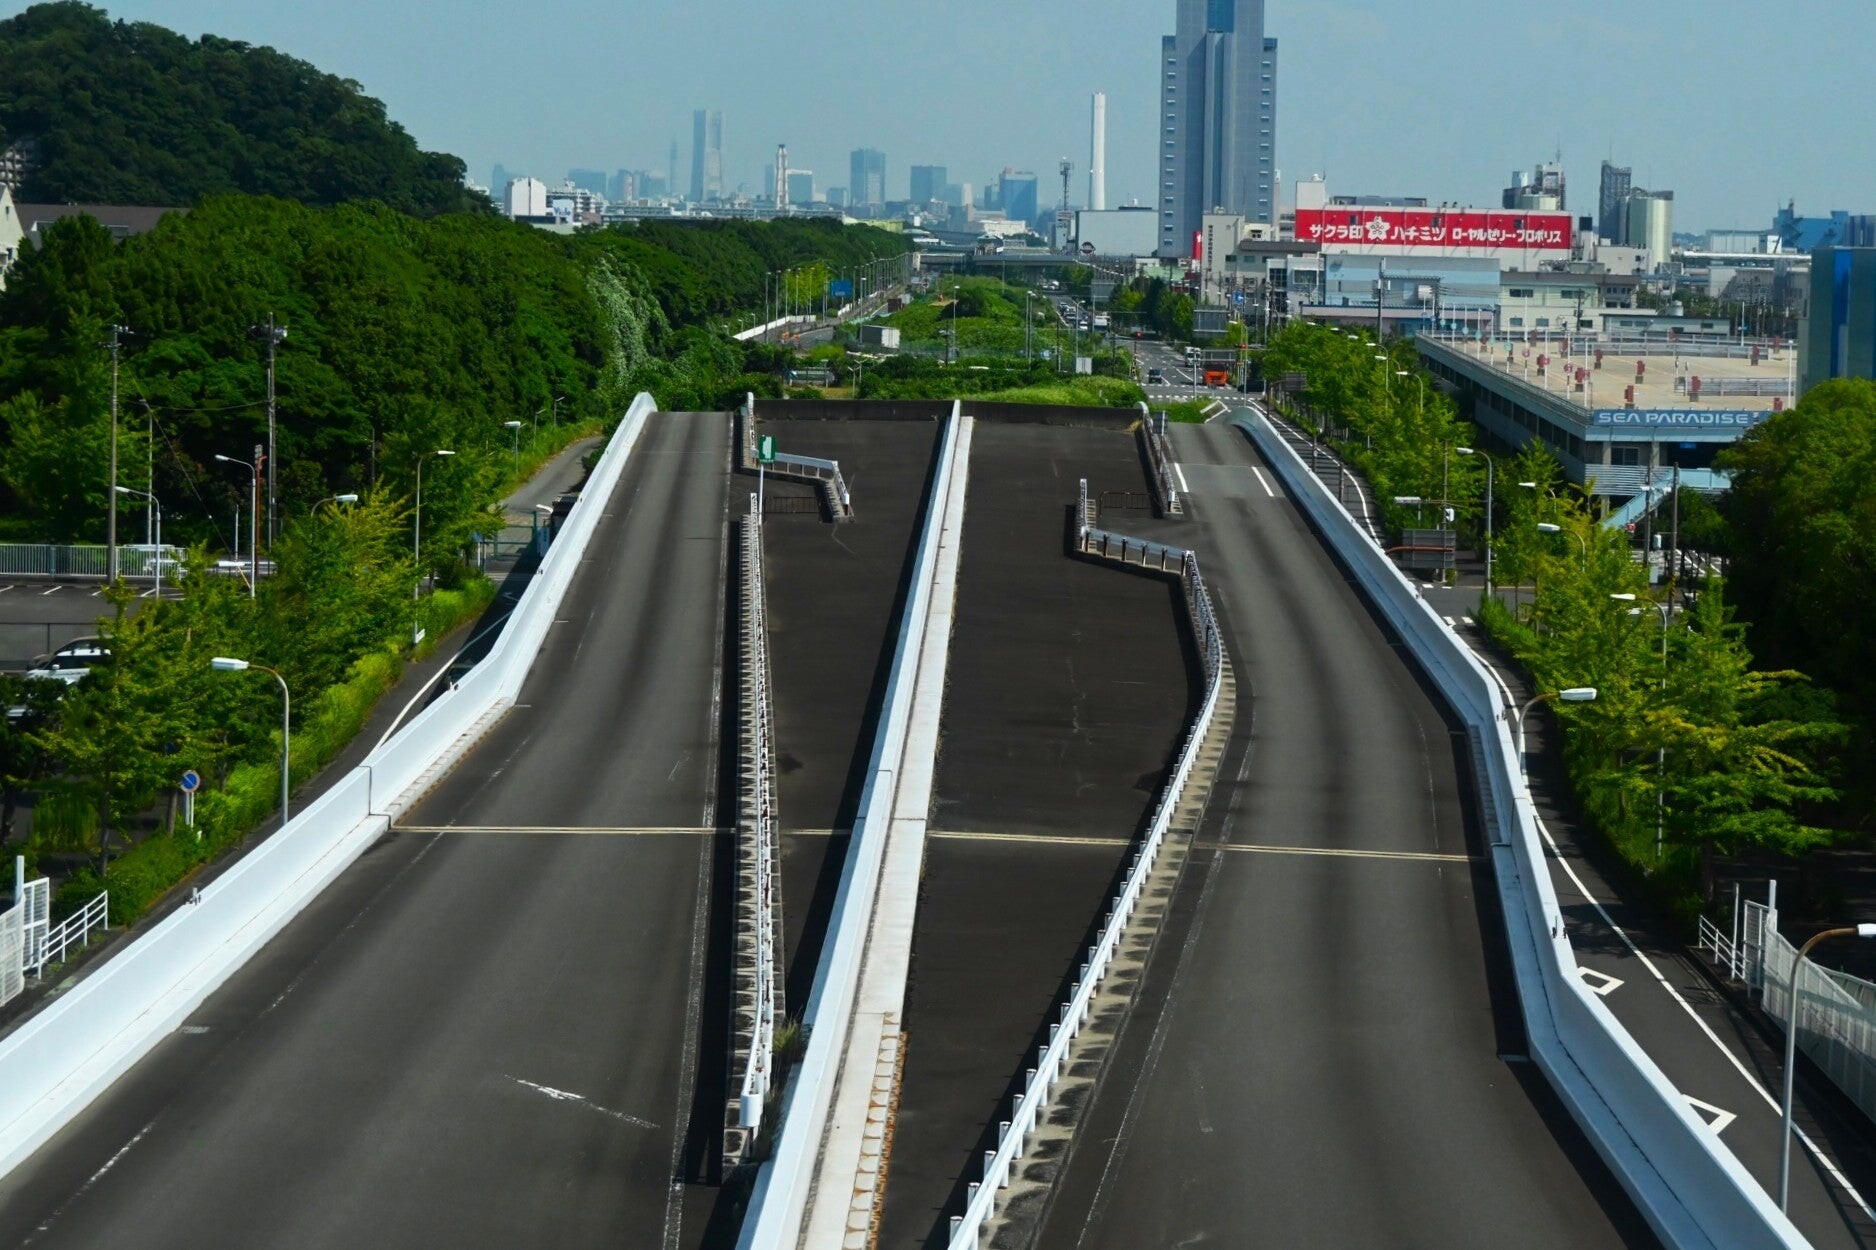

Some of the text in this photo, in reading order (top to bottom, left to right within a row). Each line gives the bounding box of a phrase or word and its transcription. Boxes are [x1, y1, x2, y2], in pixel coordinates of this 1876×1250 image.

[1309, 223, 1363, 239] サクラ印
[1390, 226, 1446, 241] ハチミツ
[1599, 412, 1640, 423] SEA
[1645, 412, 1748, 424] PARADISE
